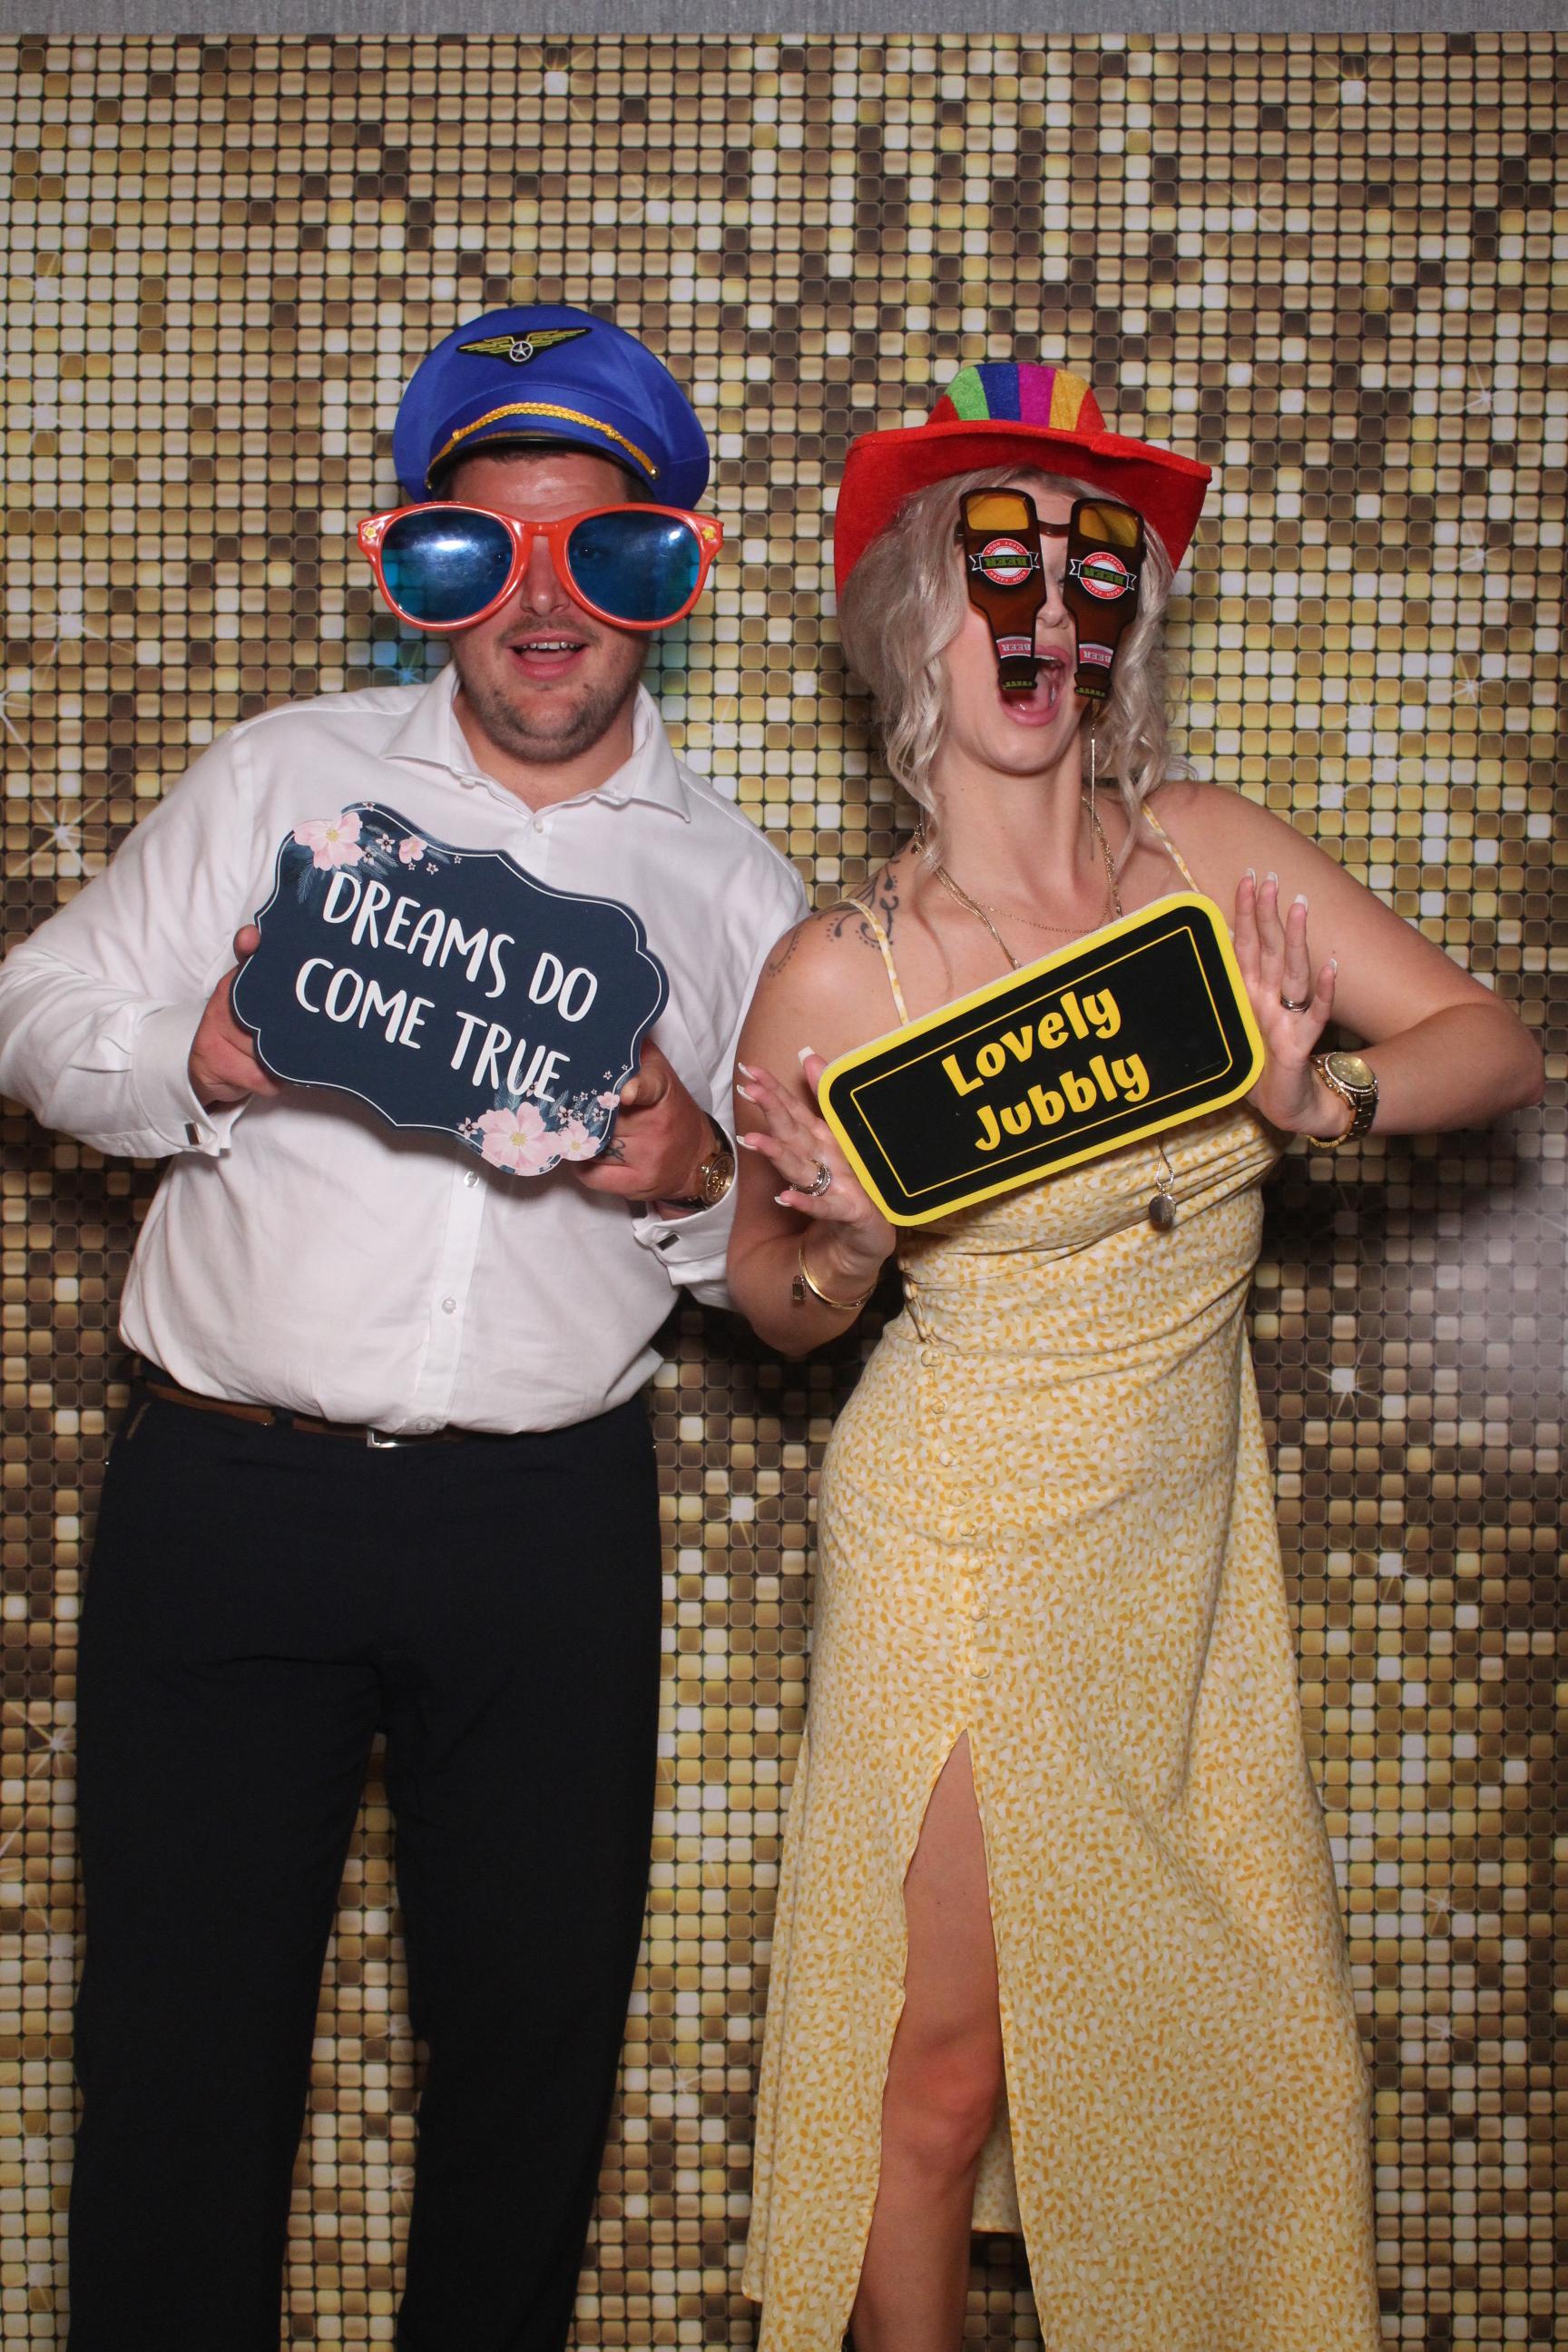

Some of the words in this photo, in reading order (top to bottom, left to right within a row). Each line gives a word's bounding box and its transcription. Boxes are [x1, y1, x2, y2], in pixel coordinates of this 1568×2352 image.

[989, 572, 1009, 583] HAPPY
[1013, 571, 1027, 582] HOUR
[1085, 581, 1102, 596] HAPPY
[1002, 643, 1031, 652] BEER
[1083, 651, 1112, 662] BEER
[322, 871, 515, 998] DREAMS
[528, 952, 598, 1022] DO
[295, 957, 436, 1049] COME
[450, 1010, 571, 1102] TRUE
[942, 988, 1122, 1097] Lovely
[975, 1053, 1151, 1152] Jubbly
